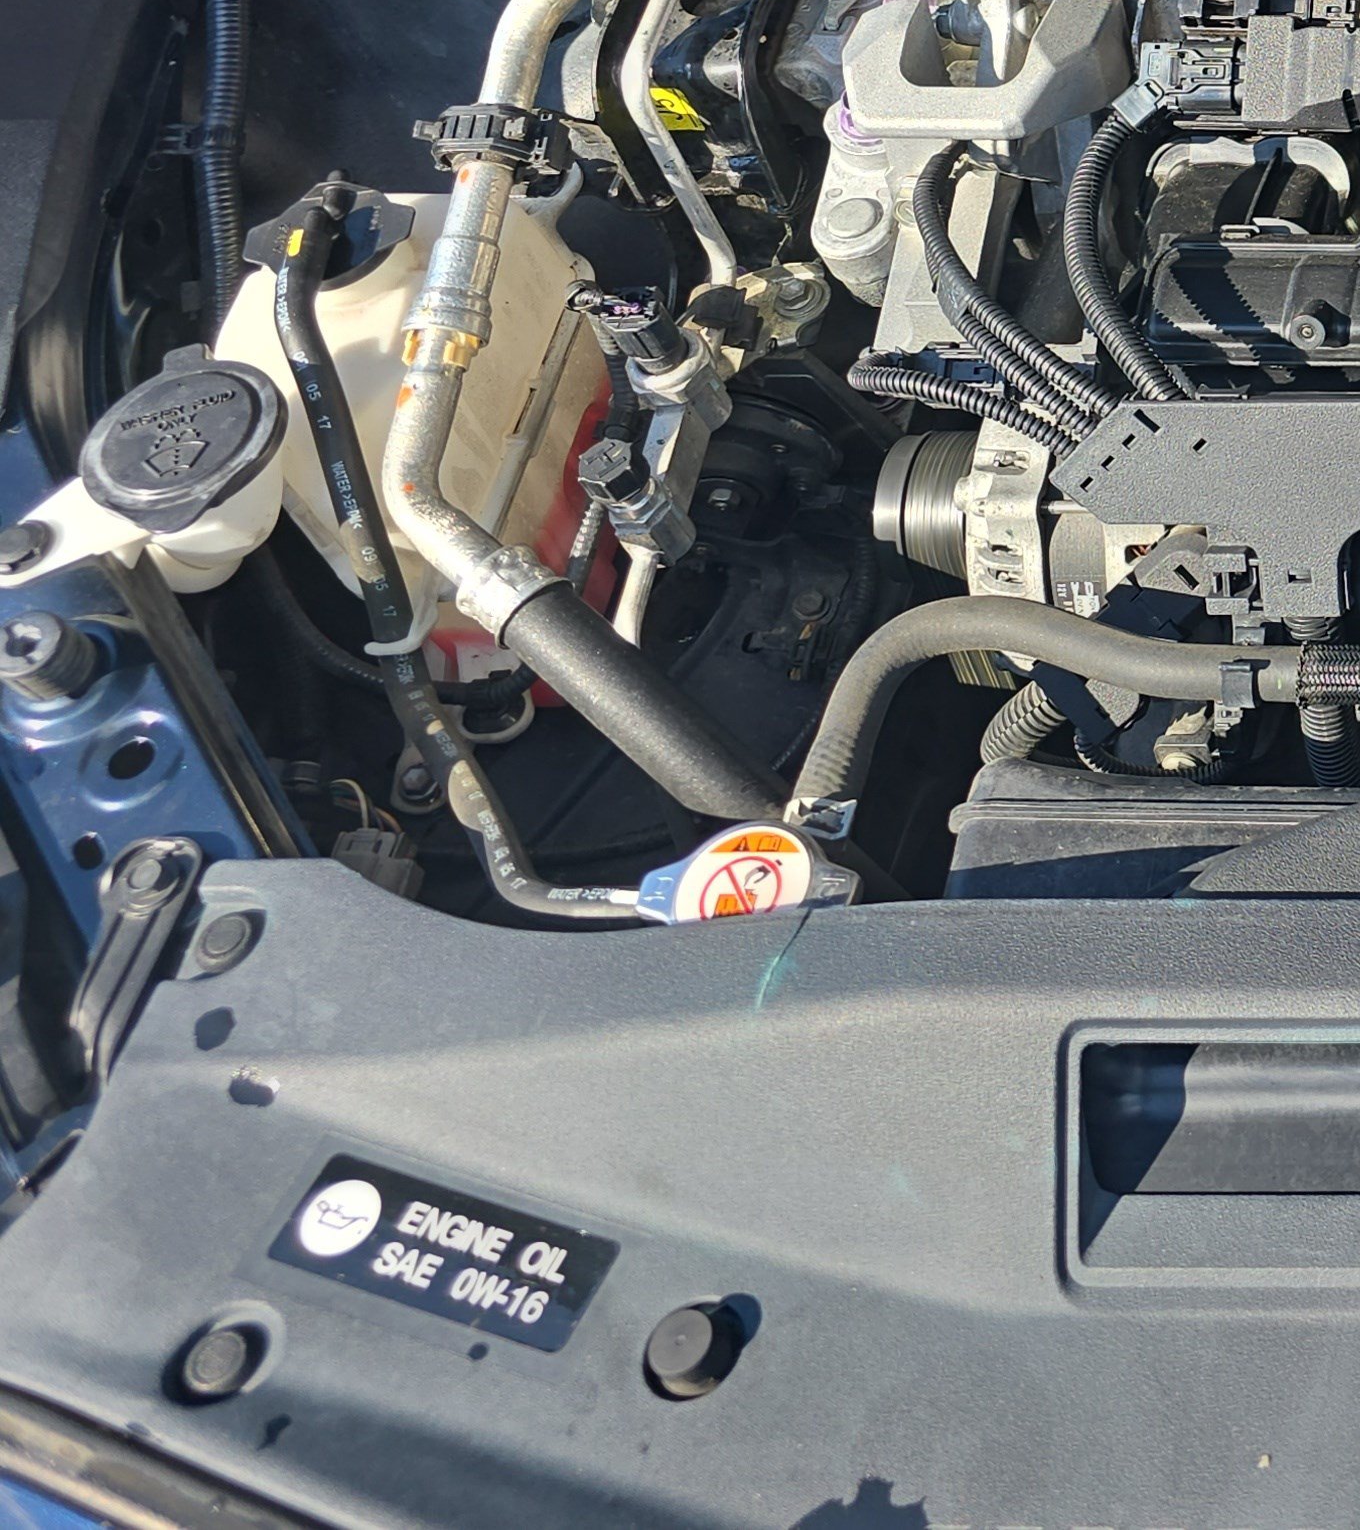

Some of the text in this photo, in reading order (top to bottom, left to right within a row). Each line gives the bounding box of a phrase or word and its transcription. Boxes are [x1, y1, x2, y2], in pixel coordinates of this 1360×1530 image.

[305, 382, 322, 402] 05
[317, 414, 332, 430] 17
[330, 461, 349, 493] WATER
[361, 546, 377, 566] 09
[383, 604, 398, 618] 17
[373, 1242, 550, 1324] SAE 0W-16
[396, 1201, 569, 1285] ENGINE OIL
